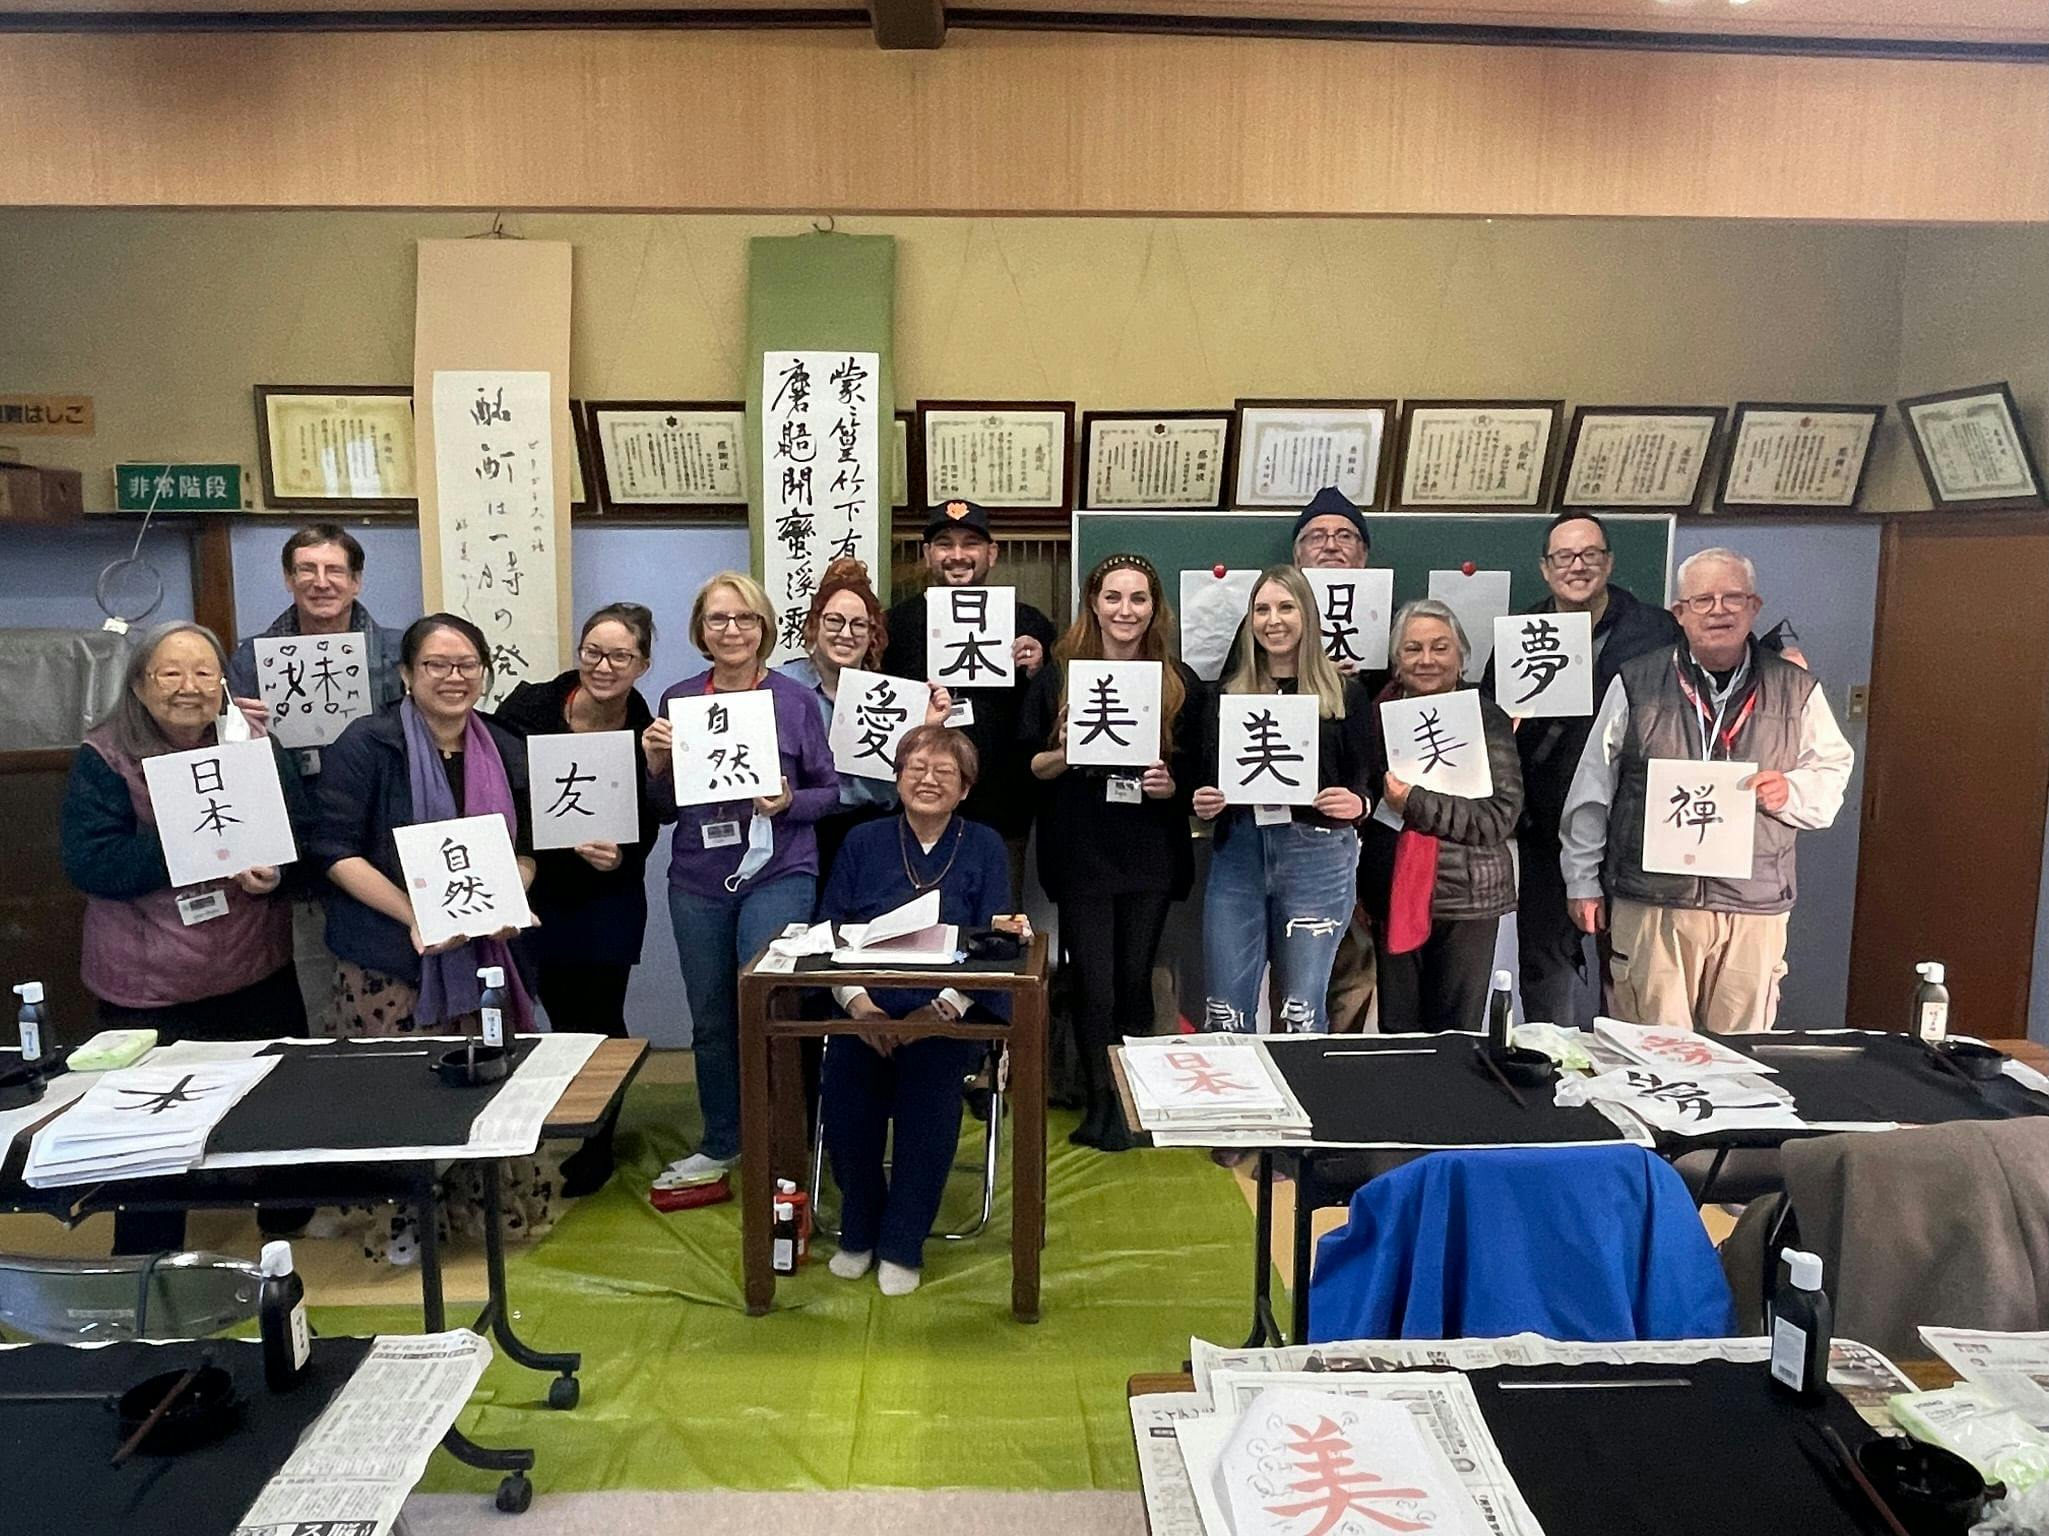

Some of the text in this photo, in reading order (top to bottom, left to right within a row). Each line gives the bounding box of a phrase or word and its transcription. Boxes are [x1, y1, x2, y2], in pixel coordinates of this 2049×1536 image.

[129, 475, 227, 499] 非常階段
[939, 590, 1007, 680] 日本
[1511, 619, 1570, 704] 夢
[706, 702, 760, 789] 自然
[853, 680, 907, 774] 愛
[1073, 674, 1139, 746] 美
[1236, 709, 1304, 786] 美
[1414, 707, 1469, 774] 美
[190, 759, 245, 837] 日本
[544, 762, 597, 818] 友
[1662, 784, 1724, 845] 禅
[439, 837, 495, 919] 自然
[1164, 1052, 1260, 1095] 日本
[1262, 1415, 1434, 1536] 美
